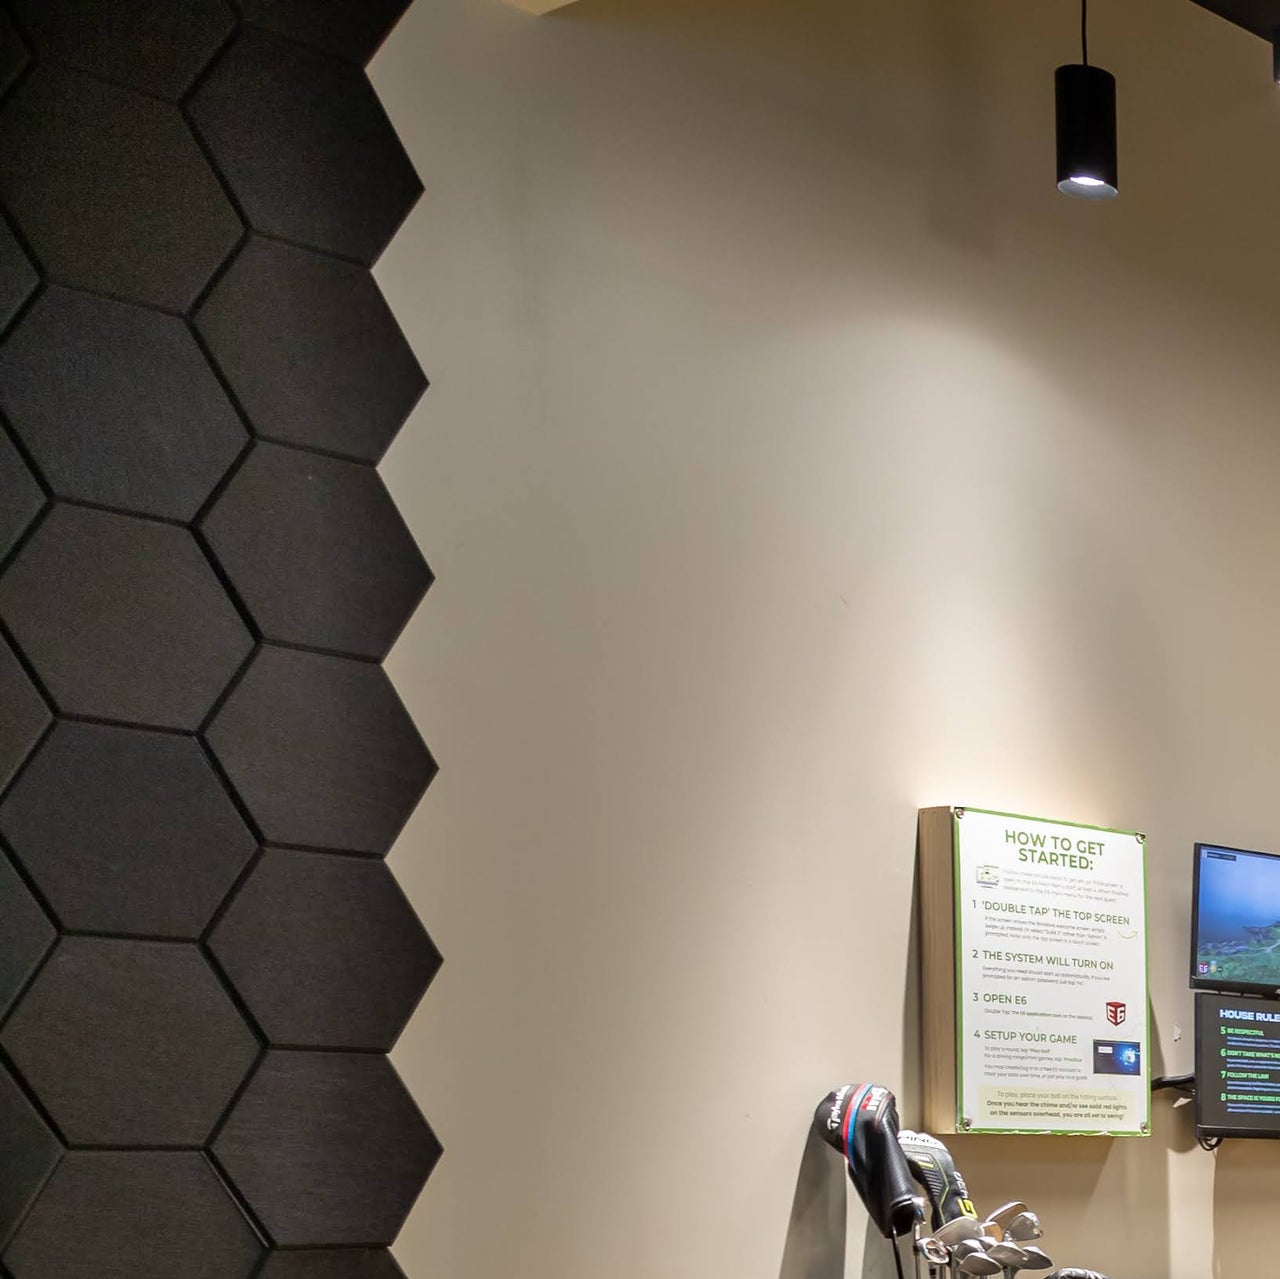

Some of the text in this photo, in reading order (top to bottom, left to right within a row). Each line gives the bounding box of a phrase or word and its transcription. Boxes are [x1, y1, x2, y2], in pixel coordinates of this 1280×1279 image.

[1004, 829, 1105, 856] HOW TO GET
[1018, 847, 1093, 871] STARTED:
[971, 899, 976, 909] 1
[1051, 908, 1070, 919] THE
[1071, 910, 1091, 922] TOP
[1093, 912, 1129, 926] SCREEN
[972, 949, 1113, 970] 2 THE SYSTEM WILL TURN ON
[972, 992, 1026, 1004] 3 OPEN E6
[1219, 1009, 1254, 1021] HOUSE
[973, 1029, 1077, 1044] 4 SETUP YOUR GAME
